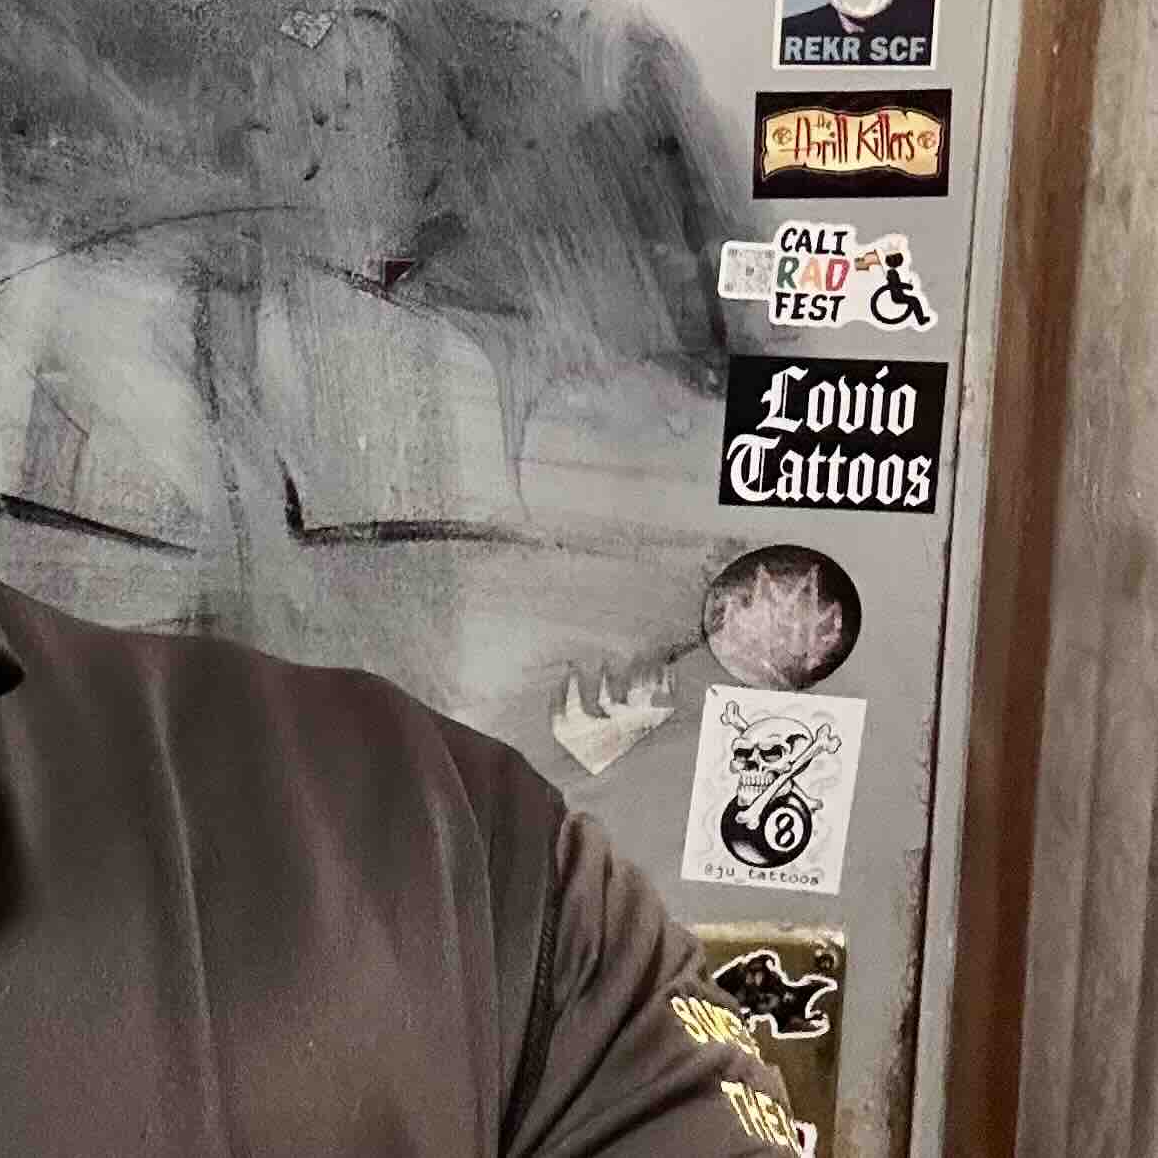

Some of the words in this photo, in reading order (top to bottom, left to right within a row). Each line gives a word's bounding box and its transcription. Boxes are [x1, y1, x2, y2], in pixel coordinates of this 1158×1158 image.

[784, 35, 860, 63] REKR
[869, 35, 927, 62] SCF
[780, 226, 848, 256] CALI
[777, 255, 851, 292] RAD
[774, 292, 846, 323] FEST
[726, 432, 933, 508] Tattoos
[774, 811, 796, 848] 8
